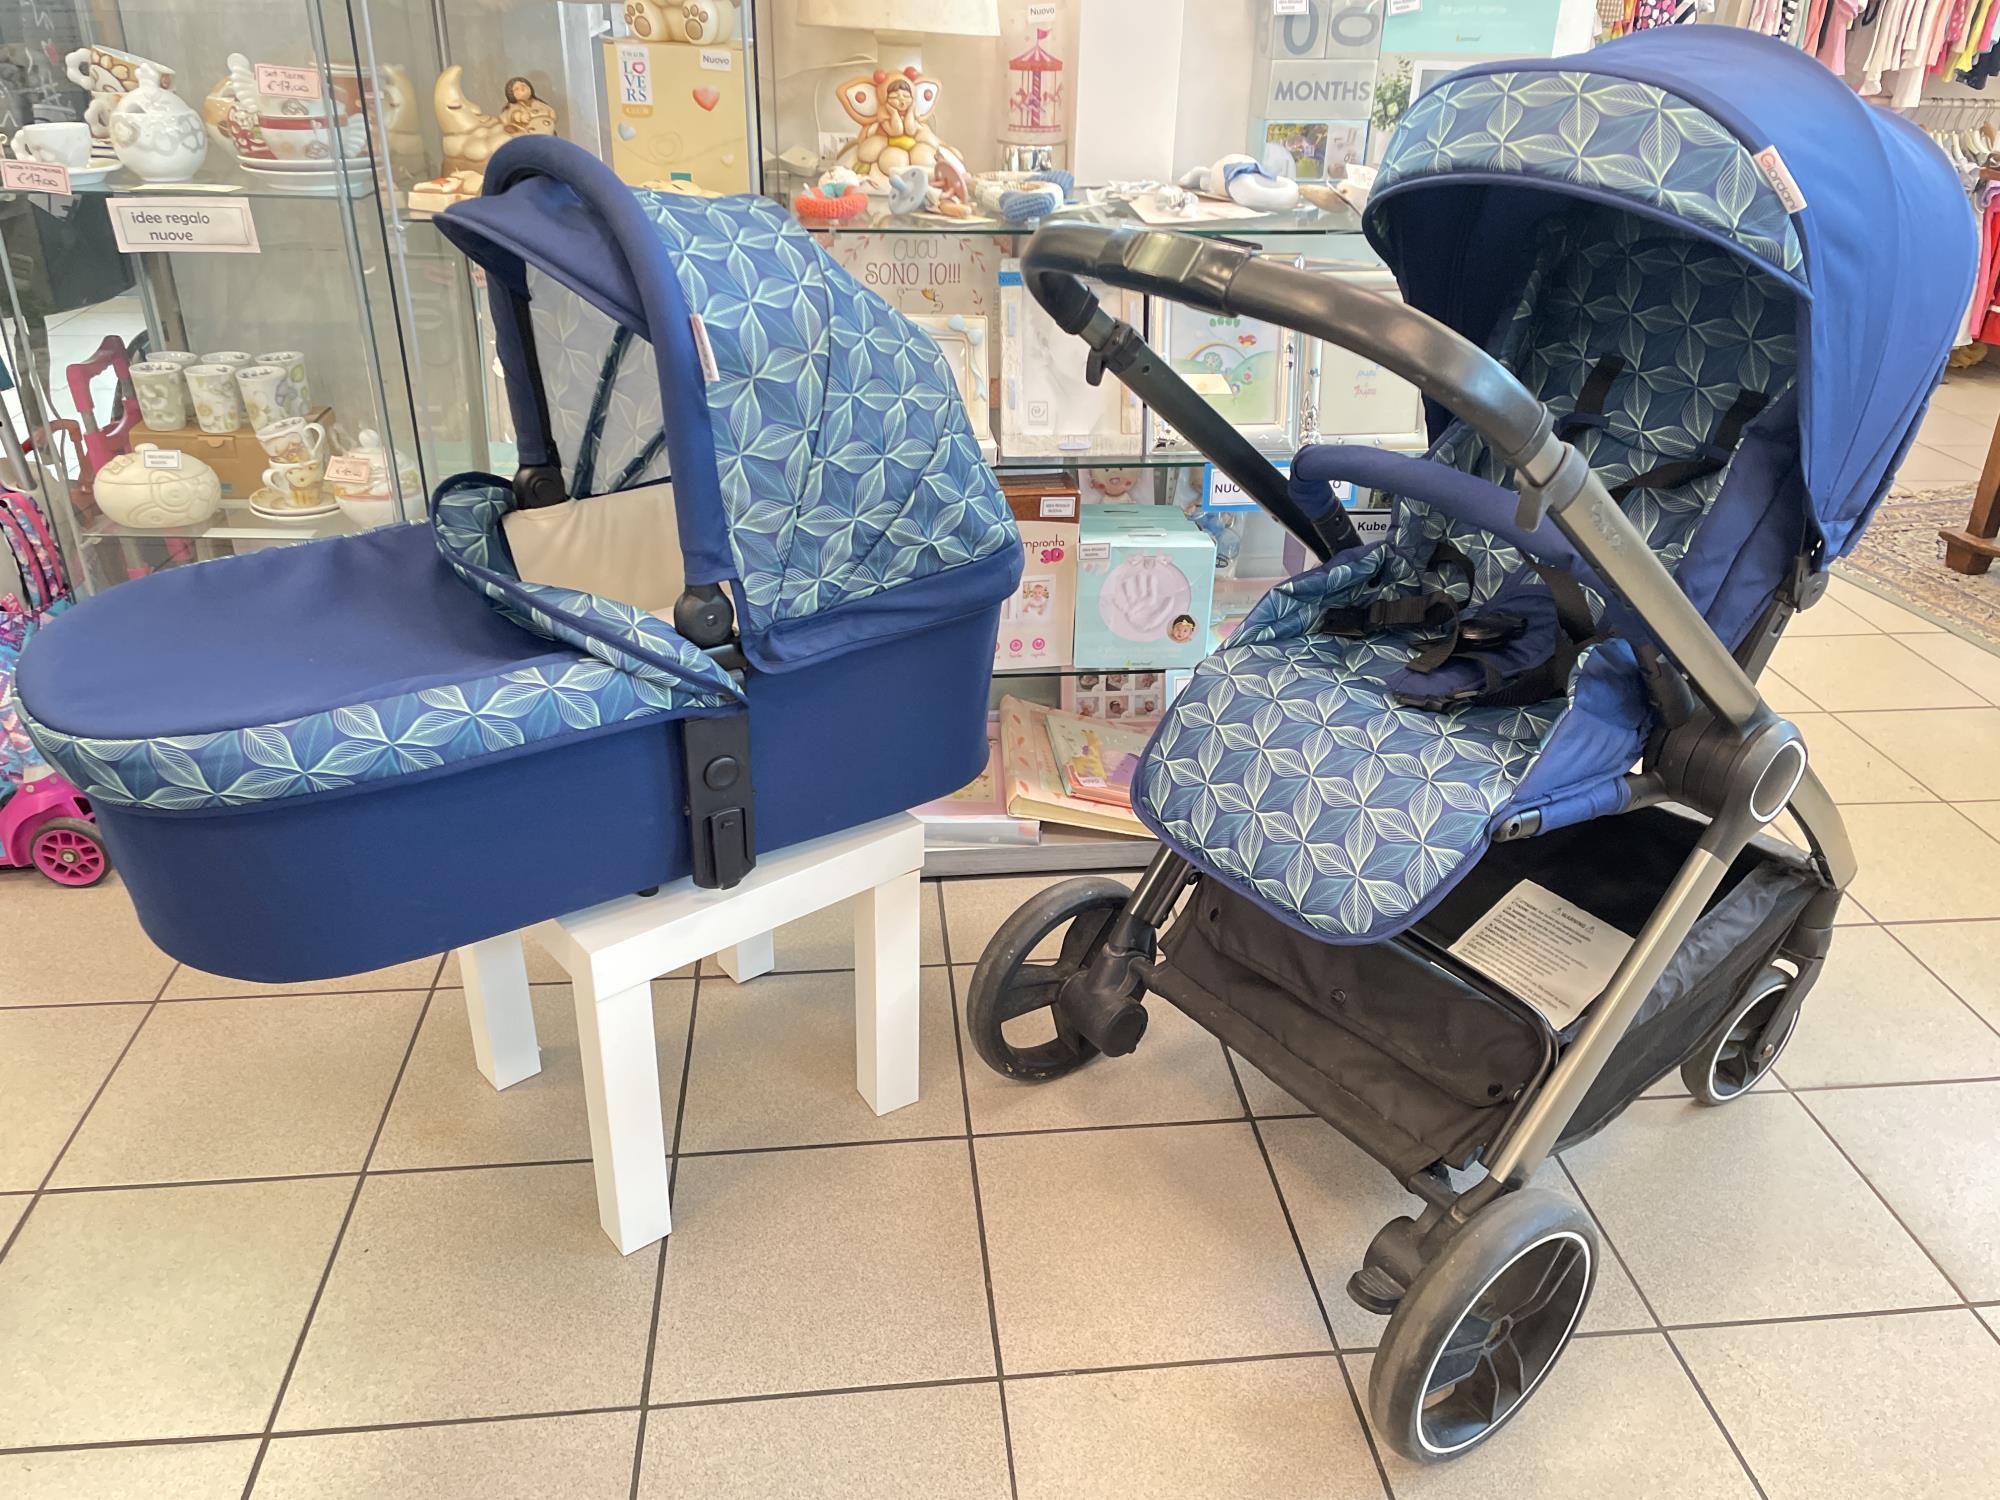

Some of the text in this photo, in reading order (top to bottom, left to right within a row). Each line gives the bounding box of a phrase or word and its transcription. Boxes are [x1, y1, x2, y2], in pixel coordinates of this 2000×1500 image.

[1030, 7, 1055, 16] Nuovo
[702, 55, 730, 65] Nuovo
[1274, 80, 1371, 101] MONTHS
[1761, 154, 1798, 210] Giordani
[130, 211, 210, 226] idee regalo
[149, 231, 194, 241] nuove
[865, 262, 961, 286] SONO IO!!!
[1357, 521, 1387, 532] Kube
[1023, 534, 1065, 554] mpronta
[1040, 547, 1065, 565] 3D
